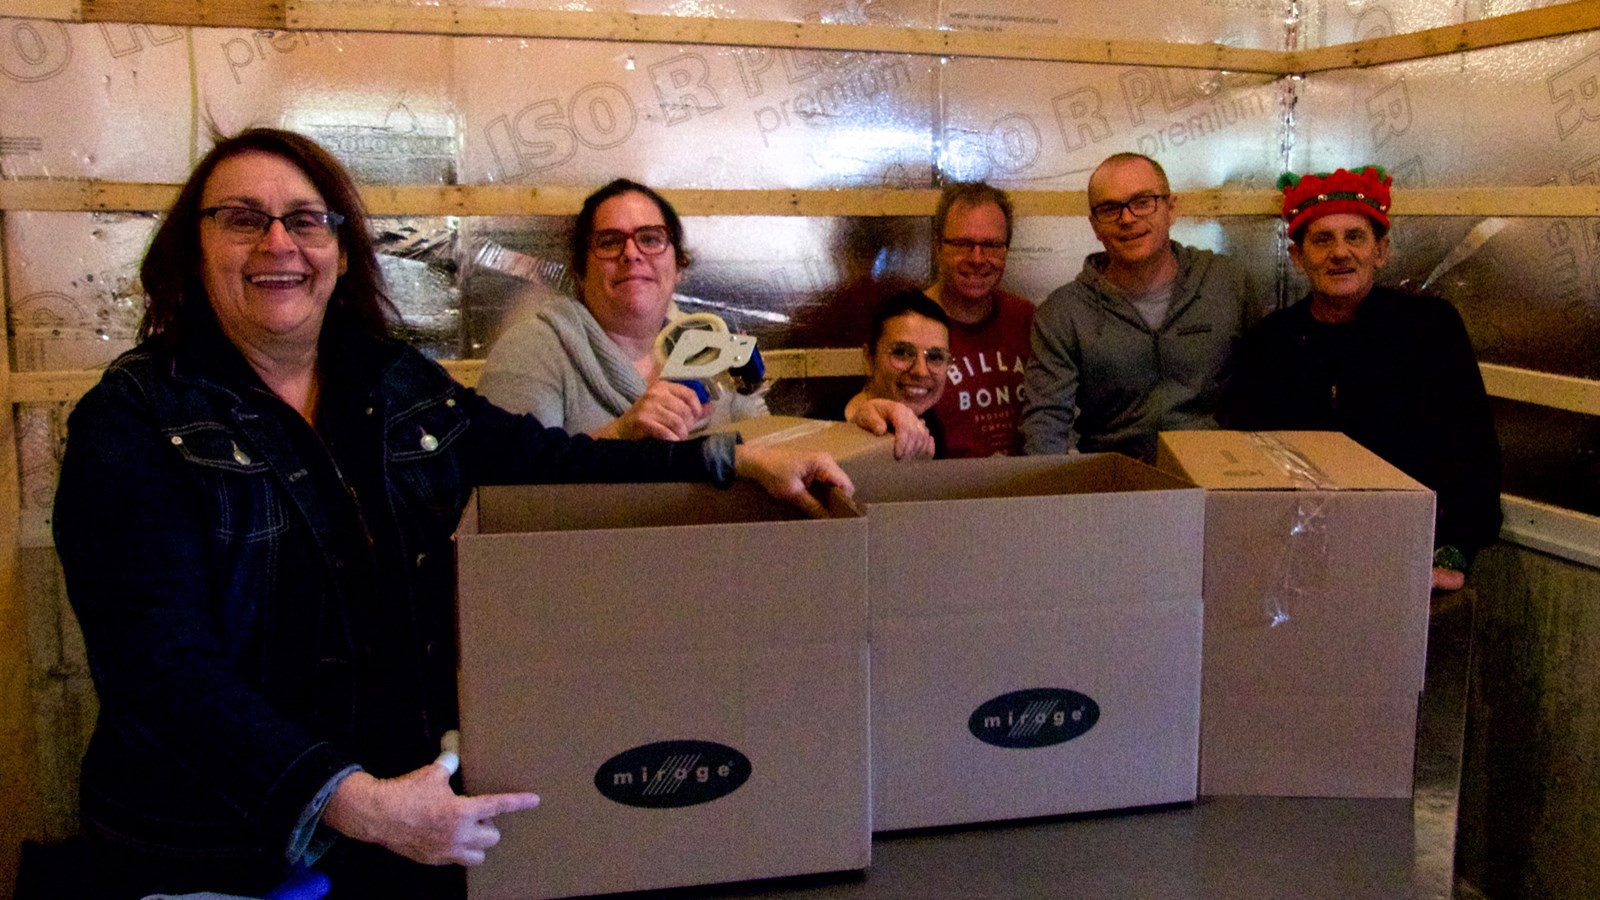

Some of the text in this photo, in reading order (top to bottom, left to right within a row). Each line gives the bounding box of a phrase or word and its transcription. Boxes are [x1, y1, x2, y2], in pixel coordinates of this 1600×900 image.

[483, 81, 636, 184] ISO
[648, 52, 725, 128] R
[753, 60, 912, 148] premium
[1051, 86, 1114, 154] R
[1136, 91, 1265, 156] premium
[947, 351, 1025, 386] BILLA
[984, 710, 1083, 728] mirage
[613, 764, 731, 785] mirage
